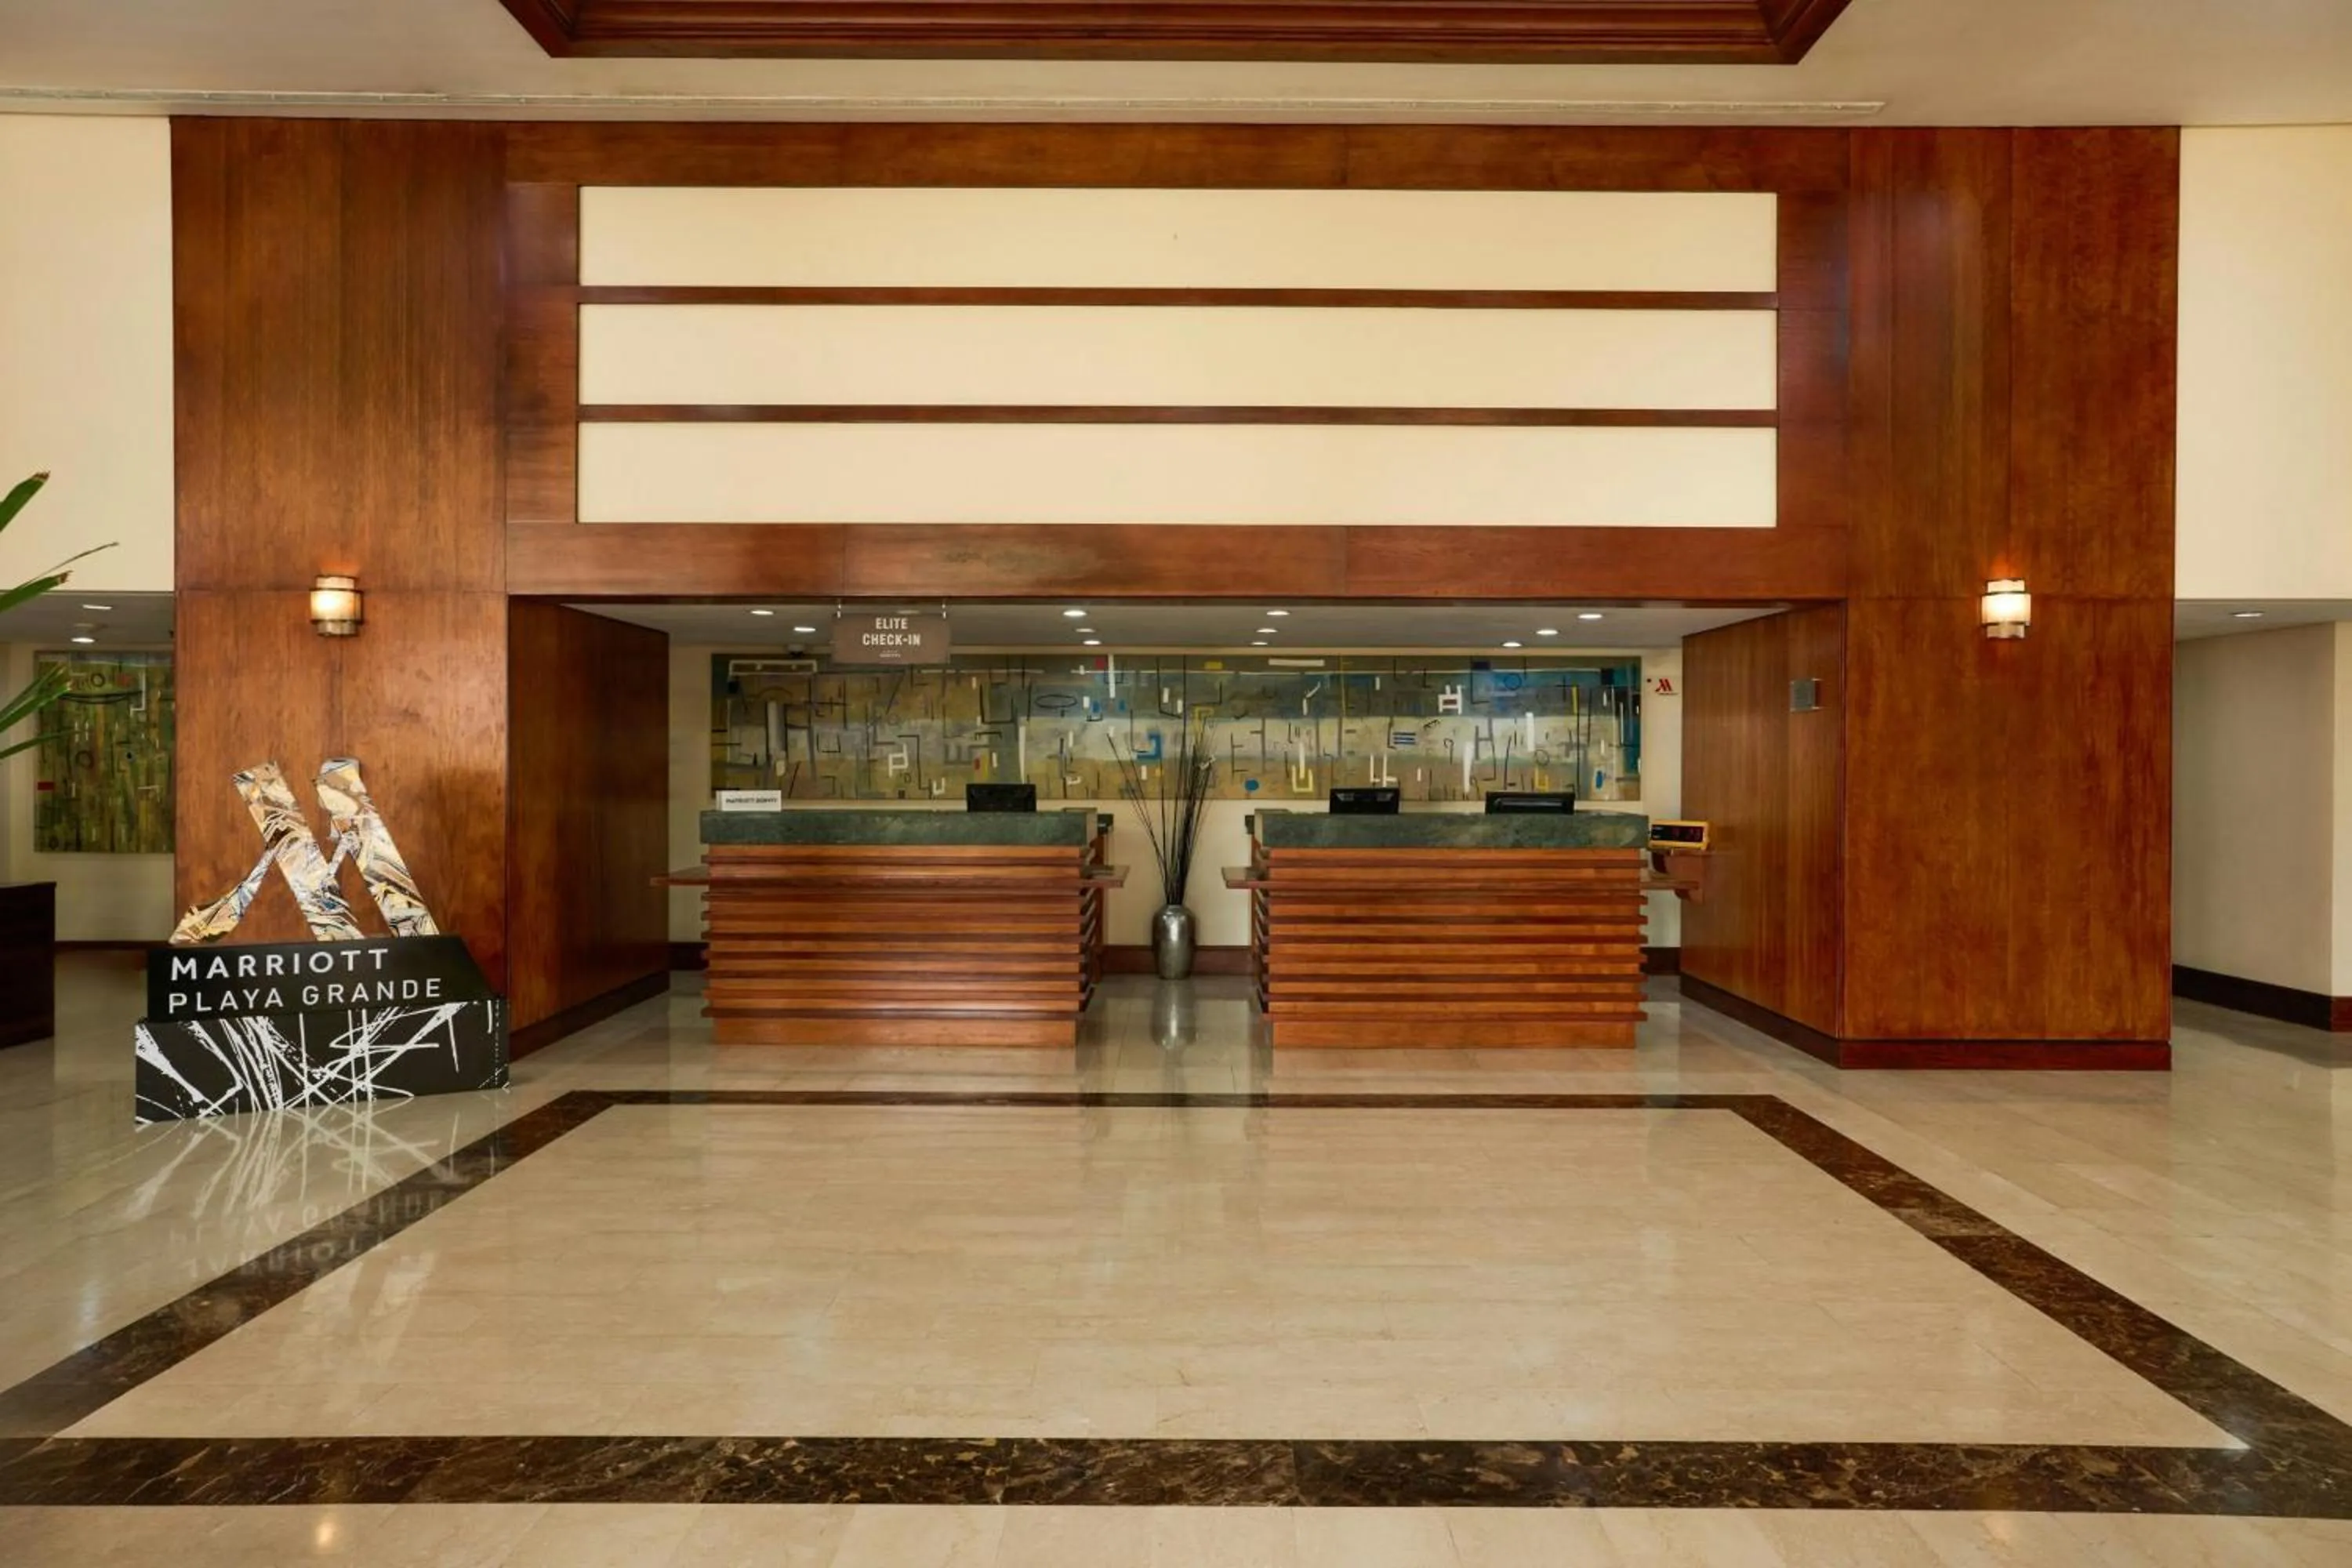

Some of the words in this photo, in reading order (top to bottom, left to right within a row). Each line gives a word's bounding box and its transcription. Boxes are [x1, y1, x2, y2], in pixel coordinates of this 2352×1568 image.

[875, 617, 908, 630] ELITE
[862, 633, 921, 646] CHECK-IN
[171, 949, 389, 981] MARRIOTT
[169, 988, 284, 1014] PLAYA
[302, 978, 441, 1006] GRANDE
